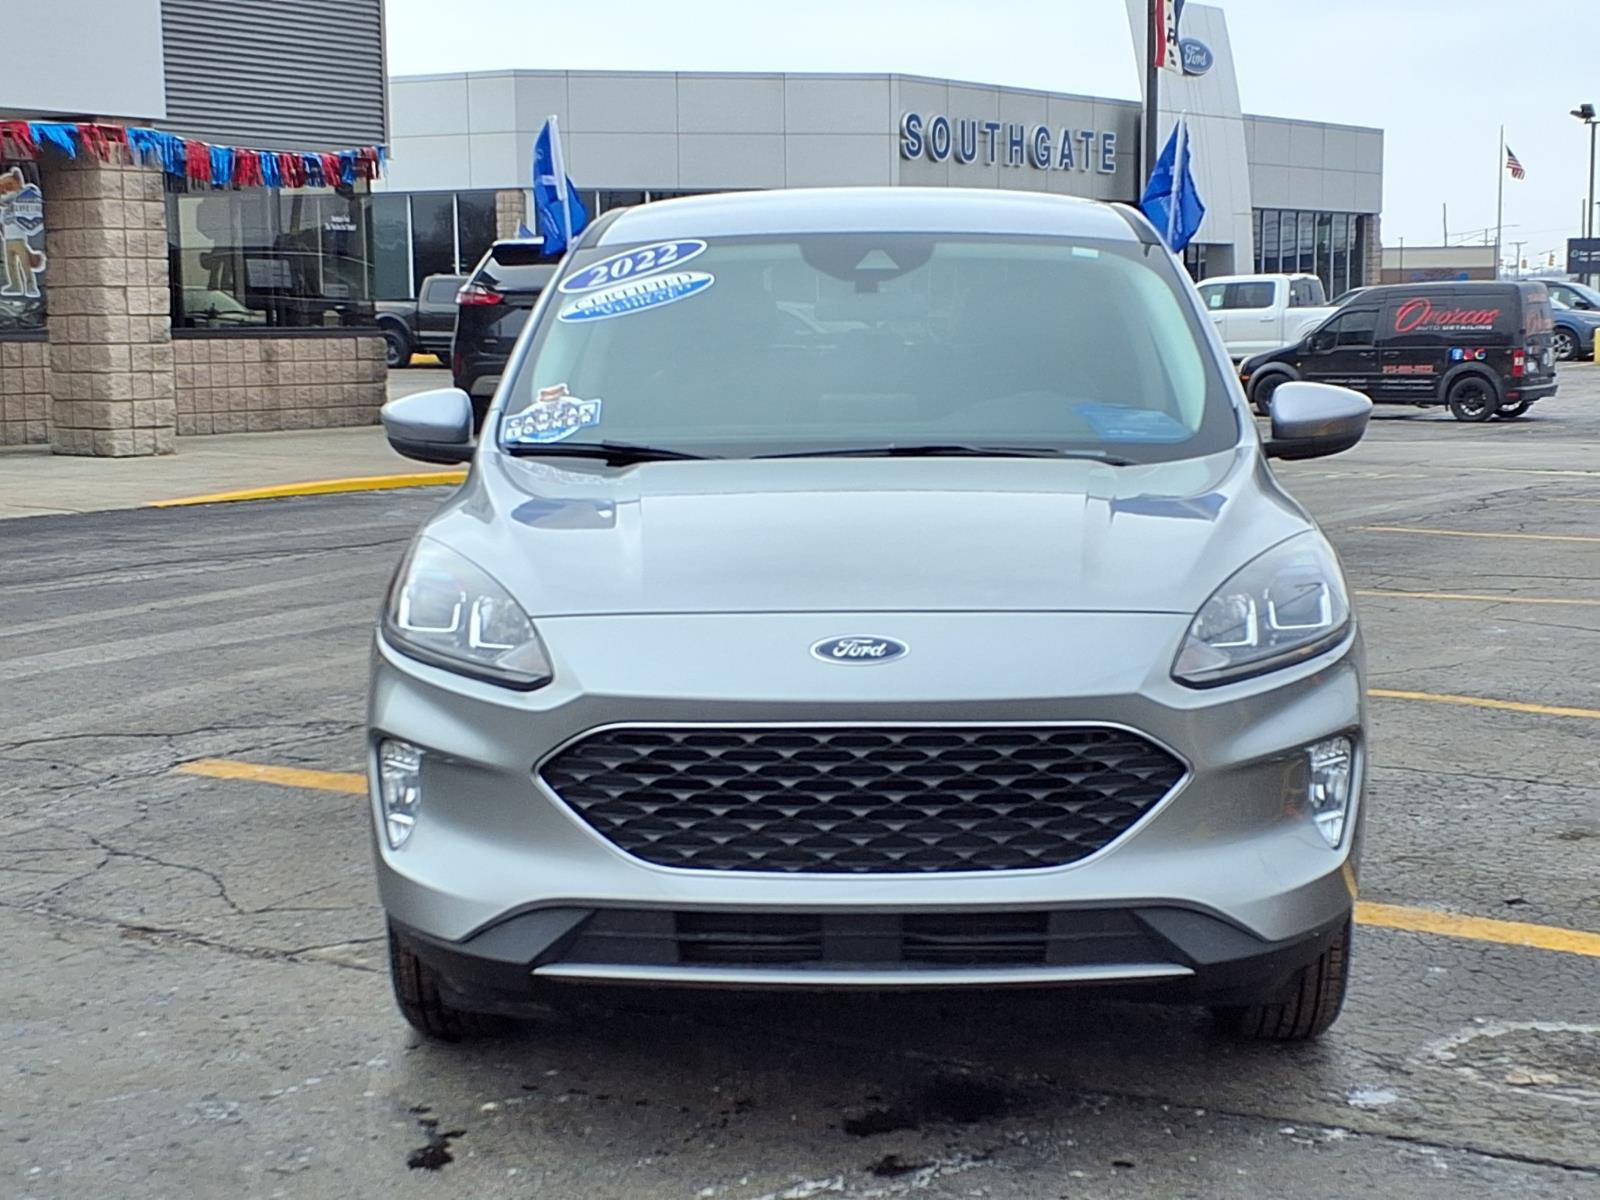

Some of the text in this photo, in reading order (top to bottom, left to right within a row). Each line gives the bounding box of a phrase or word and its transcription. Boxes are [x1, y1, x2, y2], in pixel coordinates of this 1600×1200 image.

[1184, 44, 1207, 65] Ford
[901, 111, 1117, 174] SOUTHGATE
[588, 245, 678, 285] 2022
[833, 639, 887, 657] Ford
